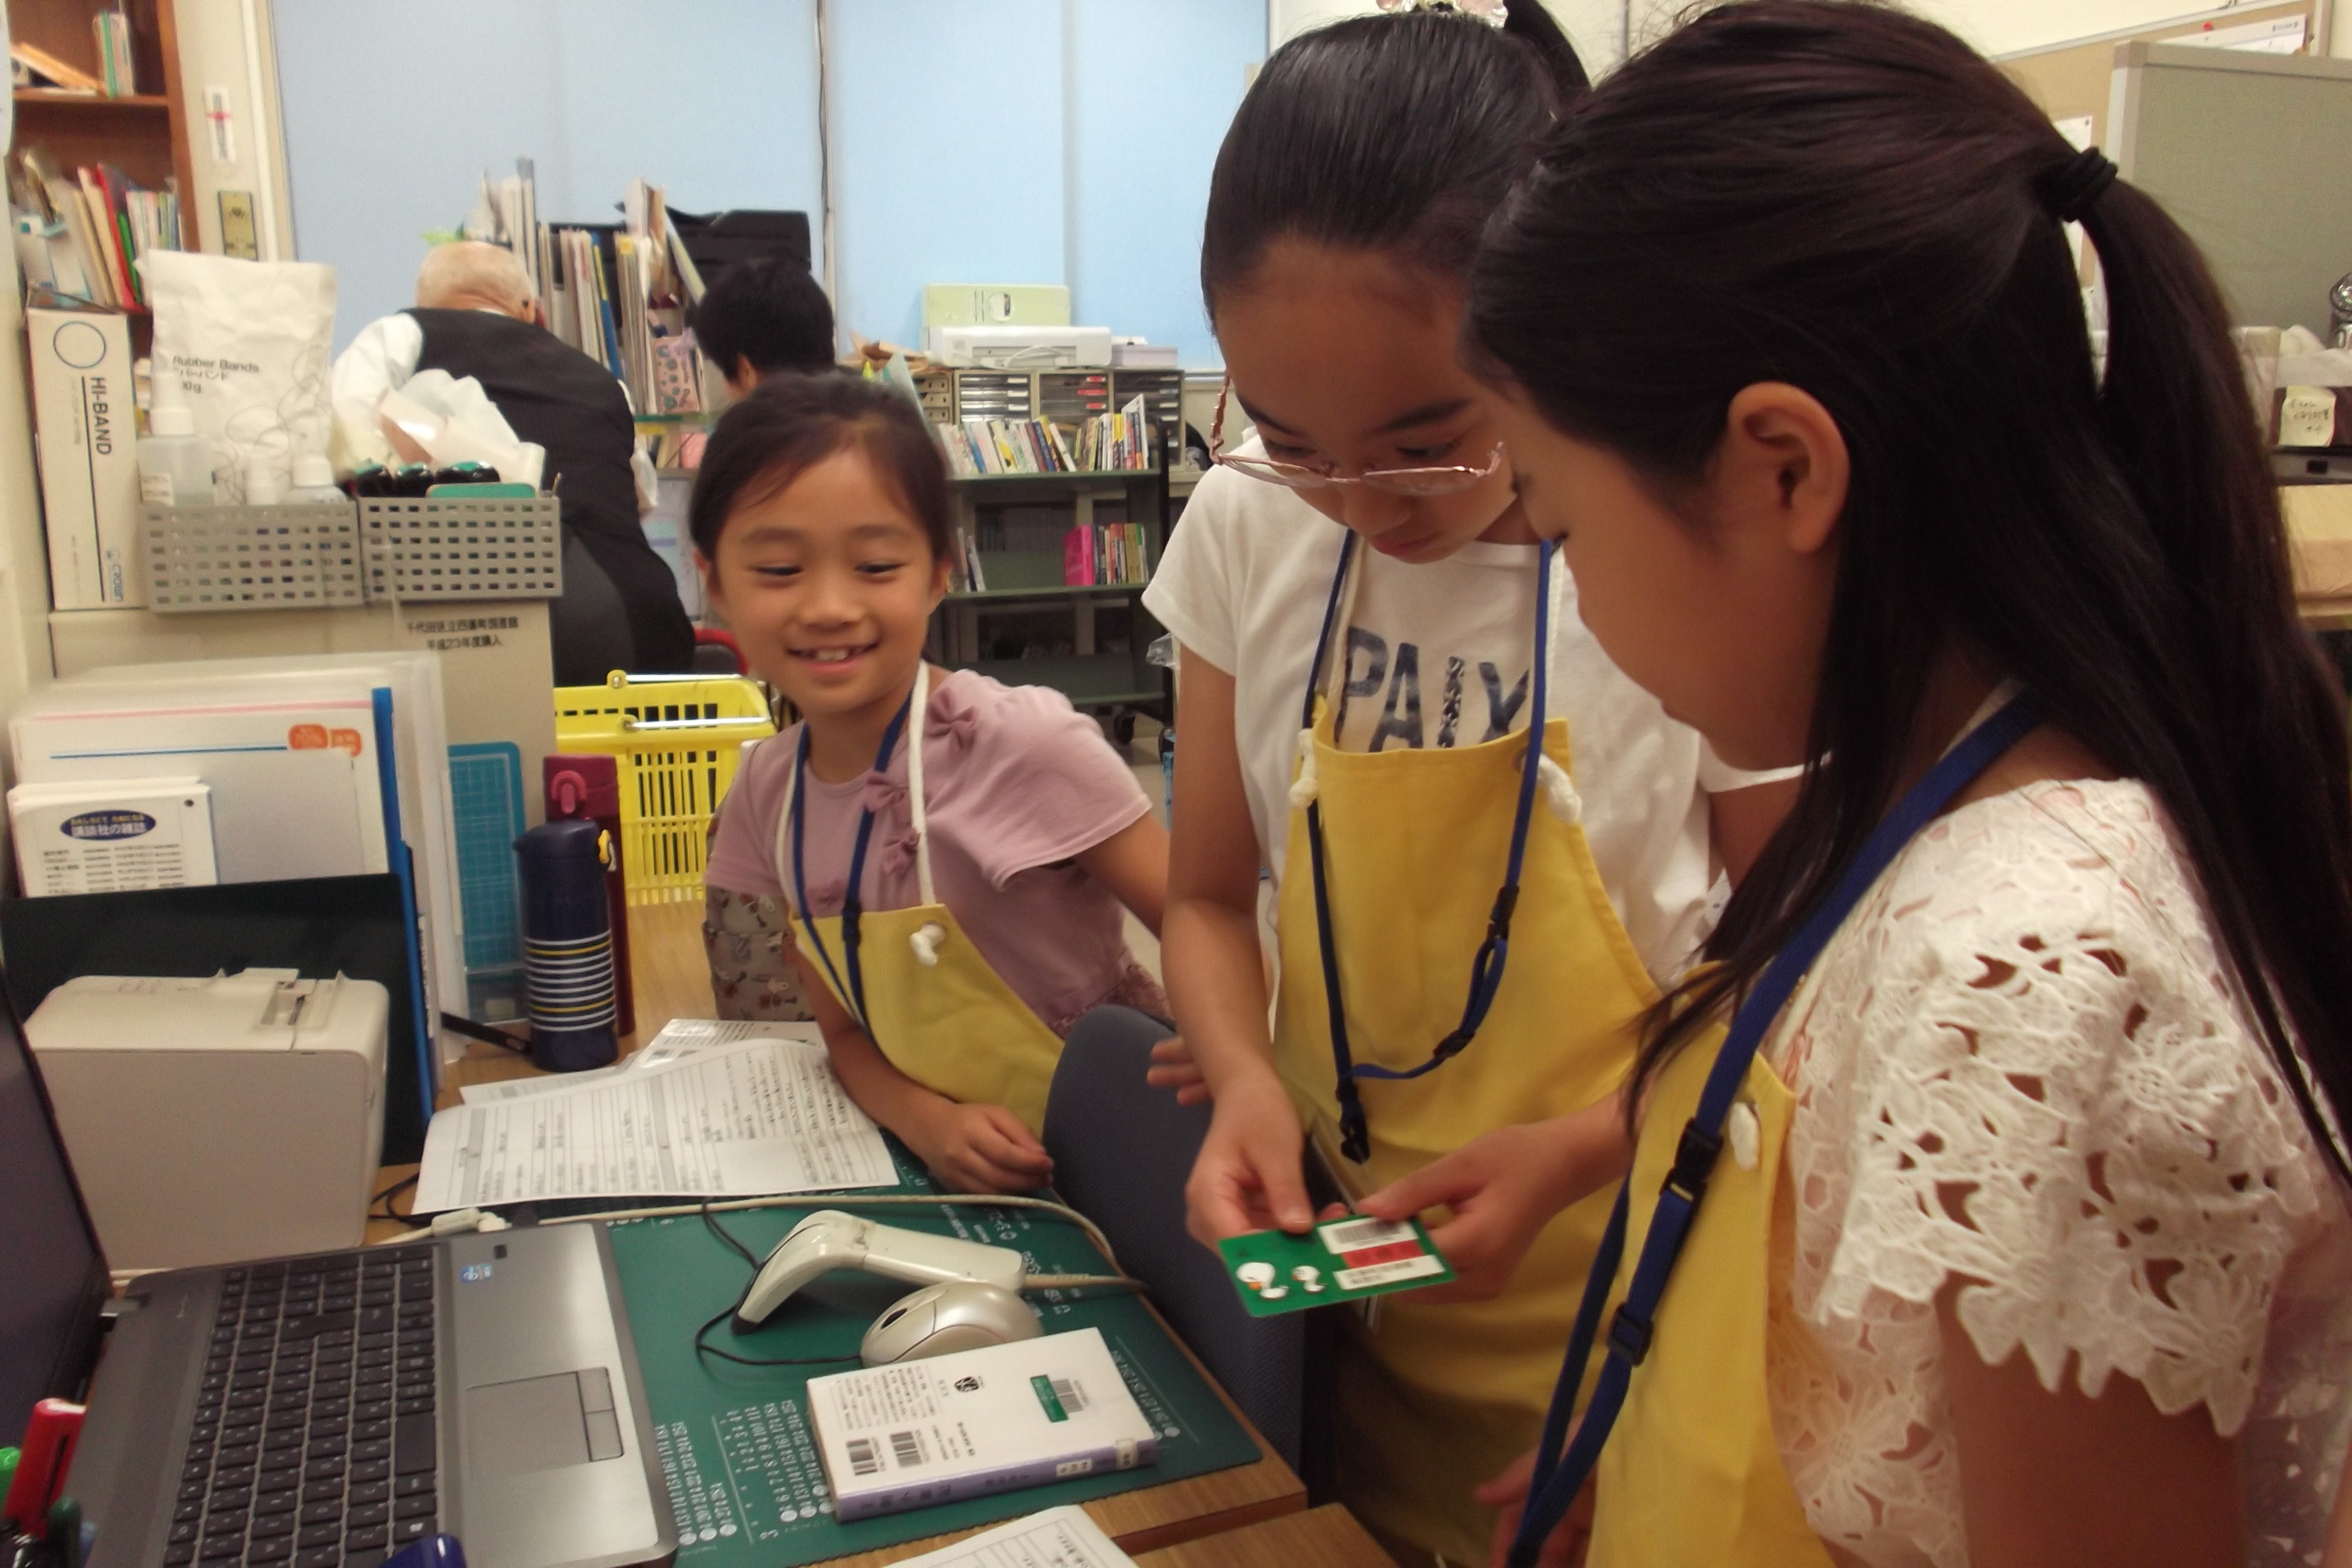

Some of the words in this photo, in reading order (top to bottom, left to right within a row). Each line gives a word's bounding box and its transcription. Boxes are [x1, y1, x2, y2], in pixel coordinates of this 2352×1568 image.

[173, 355, 214, 366] Rubber
[219, 359, 259, 373] Bands
[90, 376, 112, 455] HI-BAND
